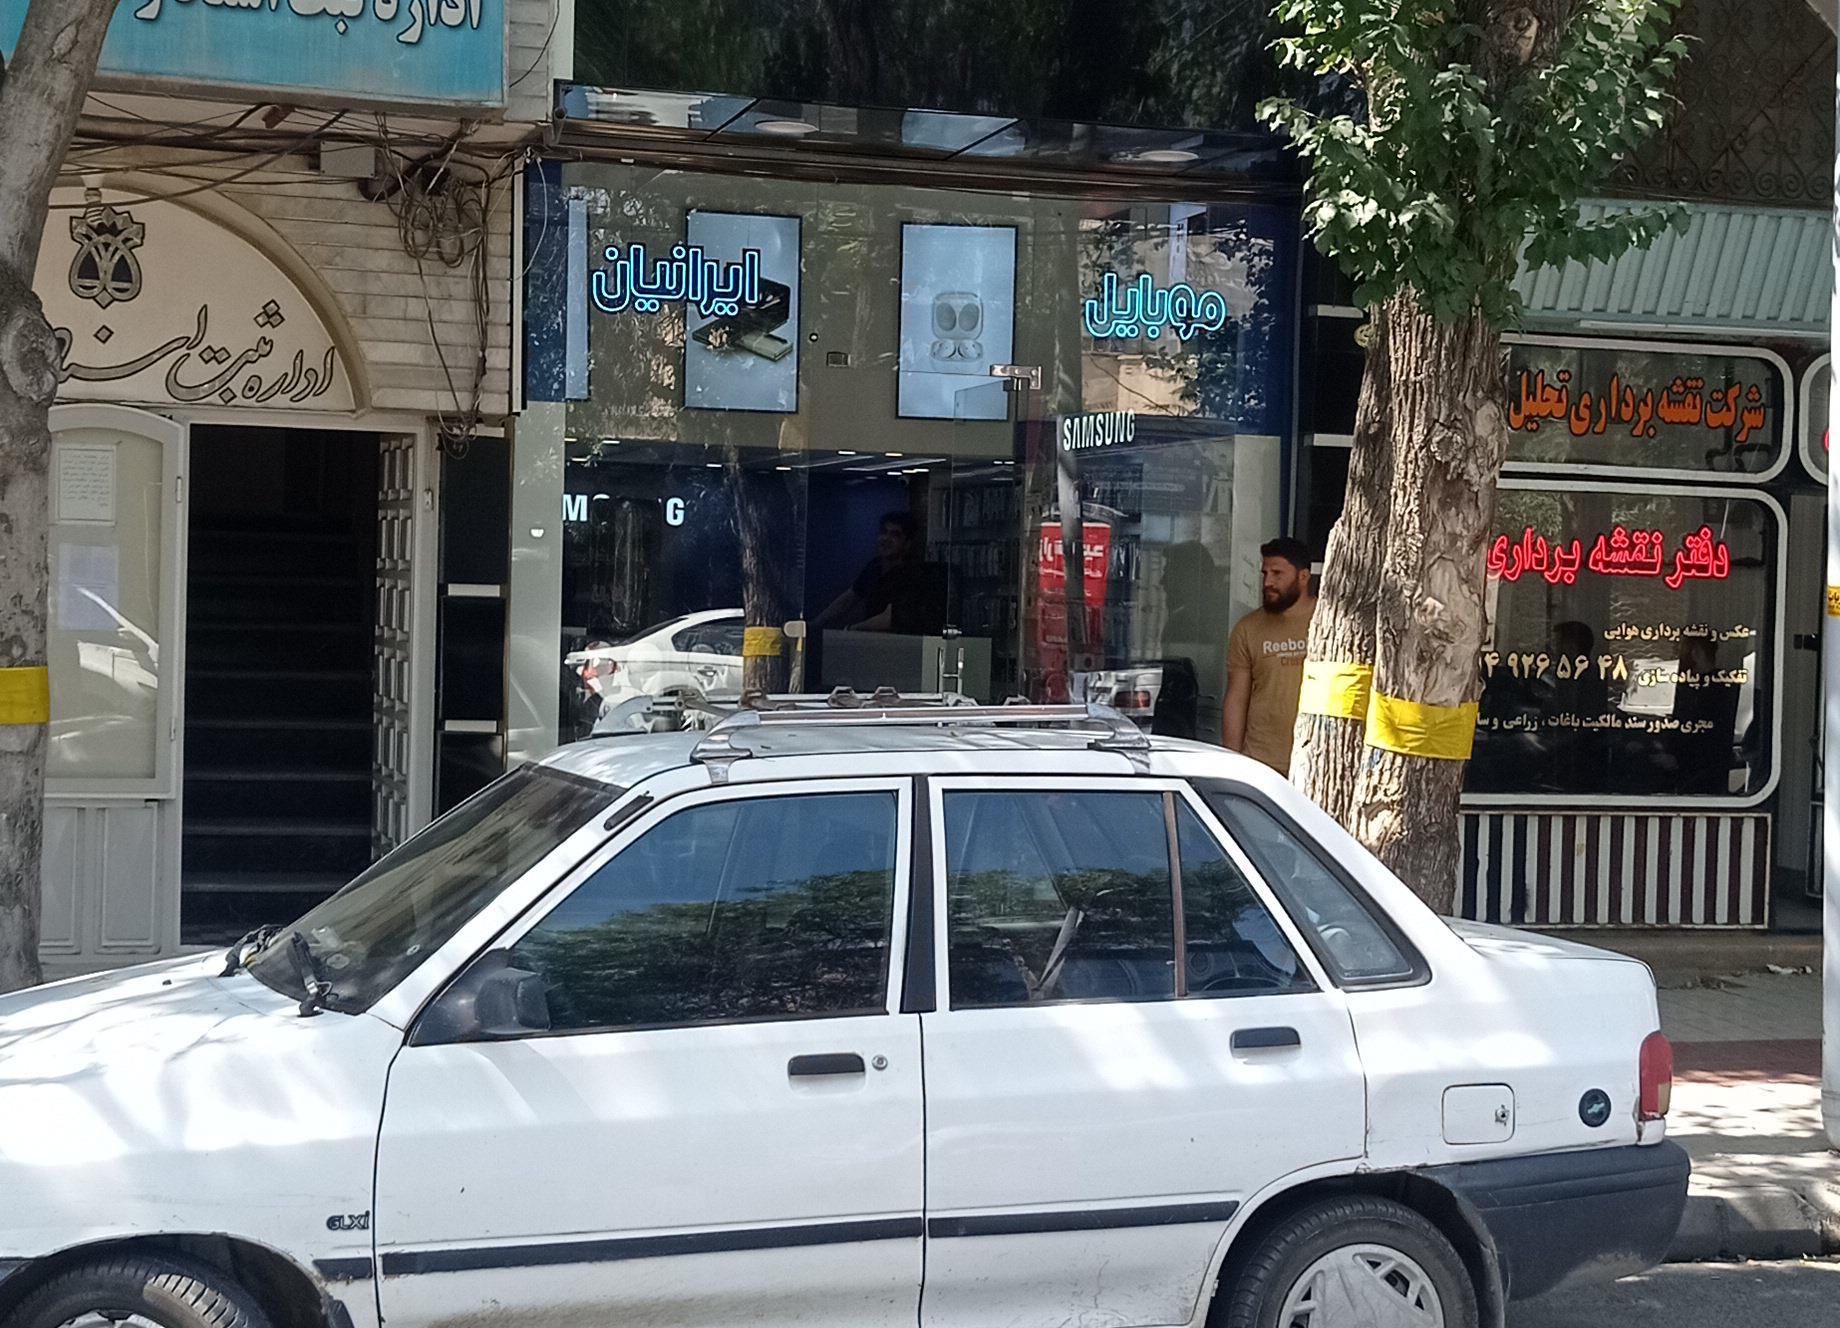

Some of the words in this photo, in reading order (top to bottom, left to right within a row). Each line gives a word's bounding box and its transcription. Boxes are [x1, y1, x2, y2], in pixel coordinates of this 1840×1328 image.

[592, 244, 759, 316] ایرانیان
[1085, 272, 1227, 341] موبایل
[165, 299, 286, 405] ثبت
[241, 346, 337, 405] اداره
[1508, 369, 1570, 432] تحلیل
[1570, 375, 1656, 437] برداری
[1657, 376, 1704, 425] نقشه
[1705, 381, 1765, 442] شرکت
[1062, 409, 1136, 452] SAMSUNG
[1487, 526, 1581, 585] برداری
[1588, 526, 1664, 577] نقشه
[1665, 522, 1731, 589] دفتر
[1603, 622, 1640, 641] هوایی
[1639, 622, 1681, 642] برداری
[1682, 623, 1709, 638] نقشه
[1709, 629, 1718, 642] و
[1262, 637, 1306, 654] Reebo
[1507, 652, 1550, 679] ۹۲۶
[1556, 654, 1590, 680] ۵۶
[1597, 655, 1629, 681] ۴۸
[1711, 669, 1749, 687] تفکیک
[1702, 673, 1711, 687] و
[1491, 718, 1500, 731] و
[1502, 713, 1539, 732] زراعی
[1582, 713, 1622, 732] مالکیت
[1624, 715, 1647, 730] سند
[1646, 718, 1680, 733] صدور
[1680, 720, 1714, 734] مجری
